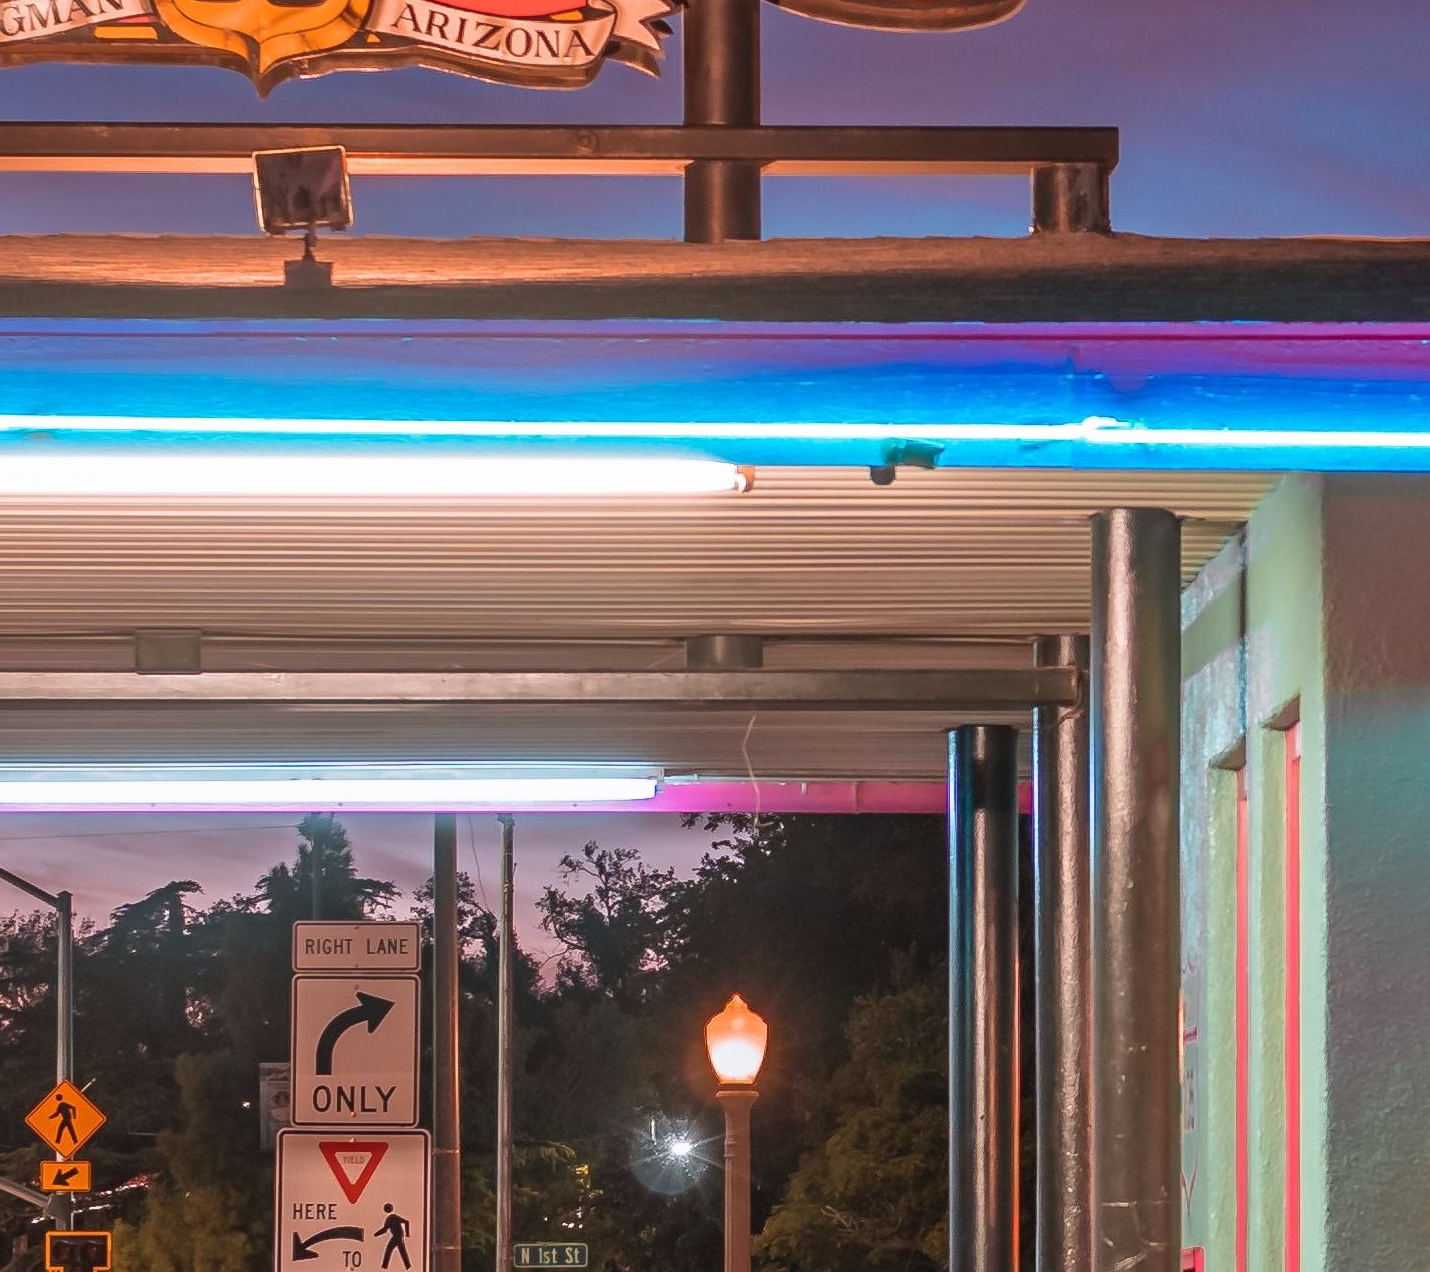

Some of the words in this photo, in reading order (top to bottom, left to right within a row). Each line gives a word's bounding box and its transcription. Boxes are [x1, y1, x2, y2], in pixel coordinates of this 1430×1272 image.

[392, 2, 595, 58] ARIZONA
[305, 938, 353, 955] RIGHT
[366, 938, 409, 955] LANE
[312, 1085, 396, 1113] ONLY
[343, 1156, 365, 1164] YIELD
[292, 1203, 338, 1220] HERE
[342, 1250, 362, 1268] TO
[521, 1247, 530, 1264] N
[538, 1247, 558, 1264] 1st
[565, 1247, 579, 1264] St
